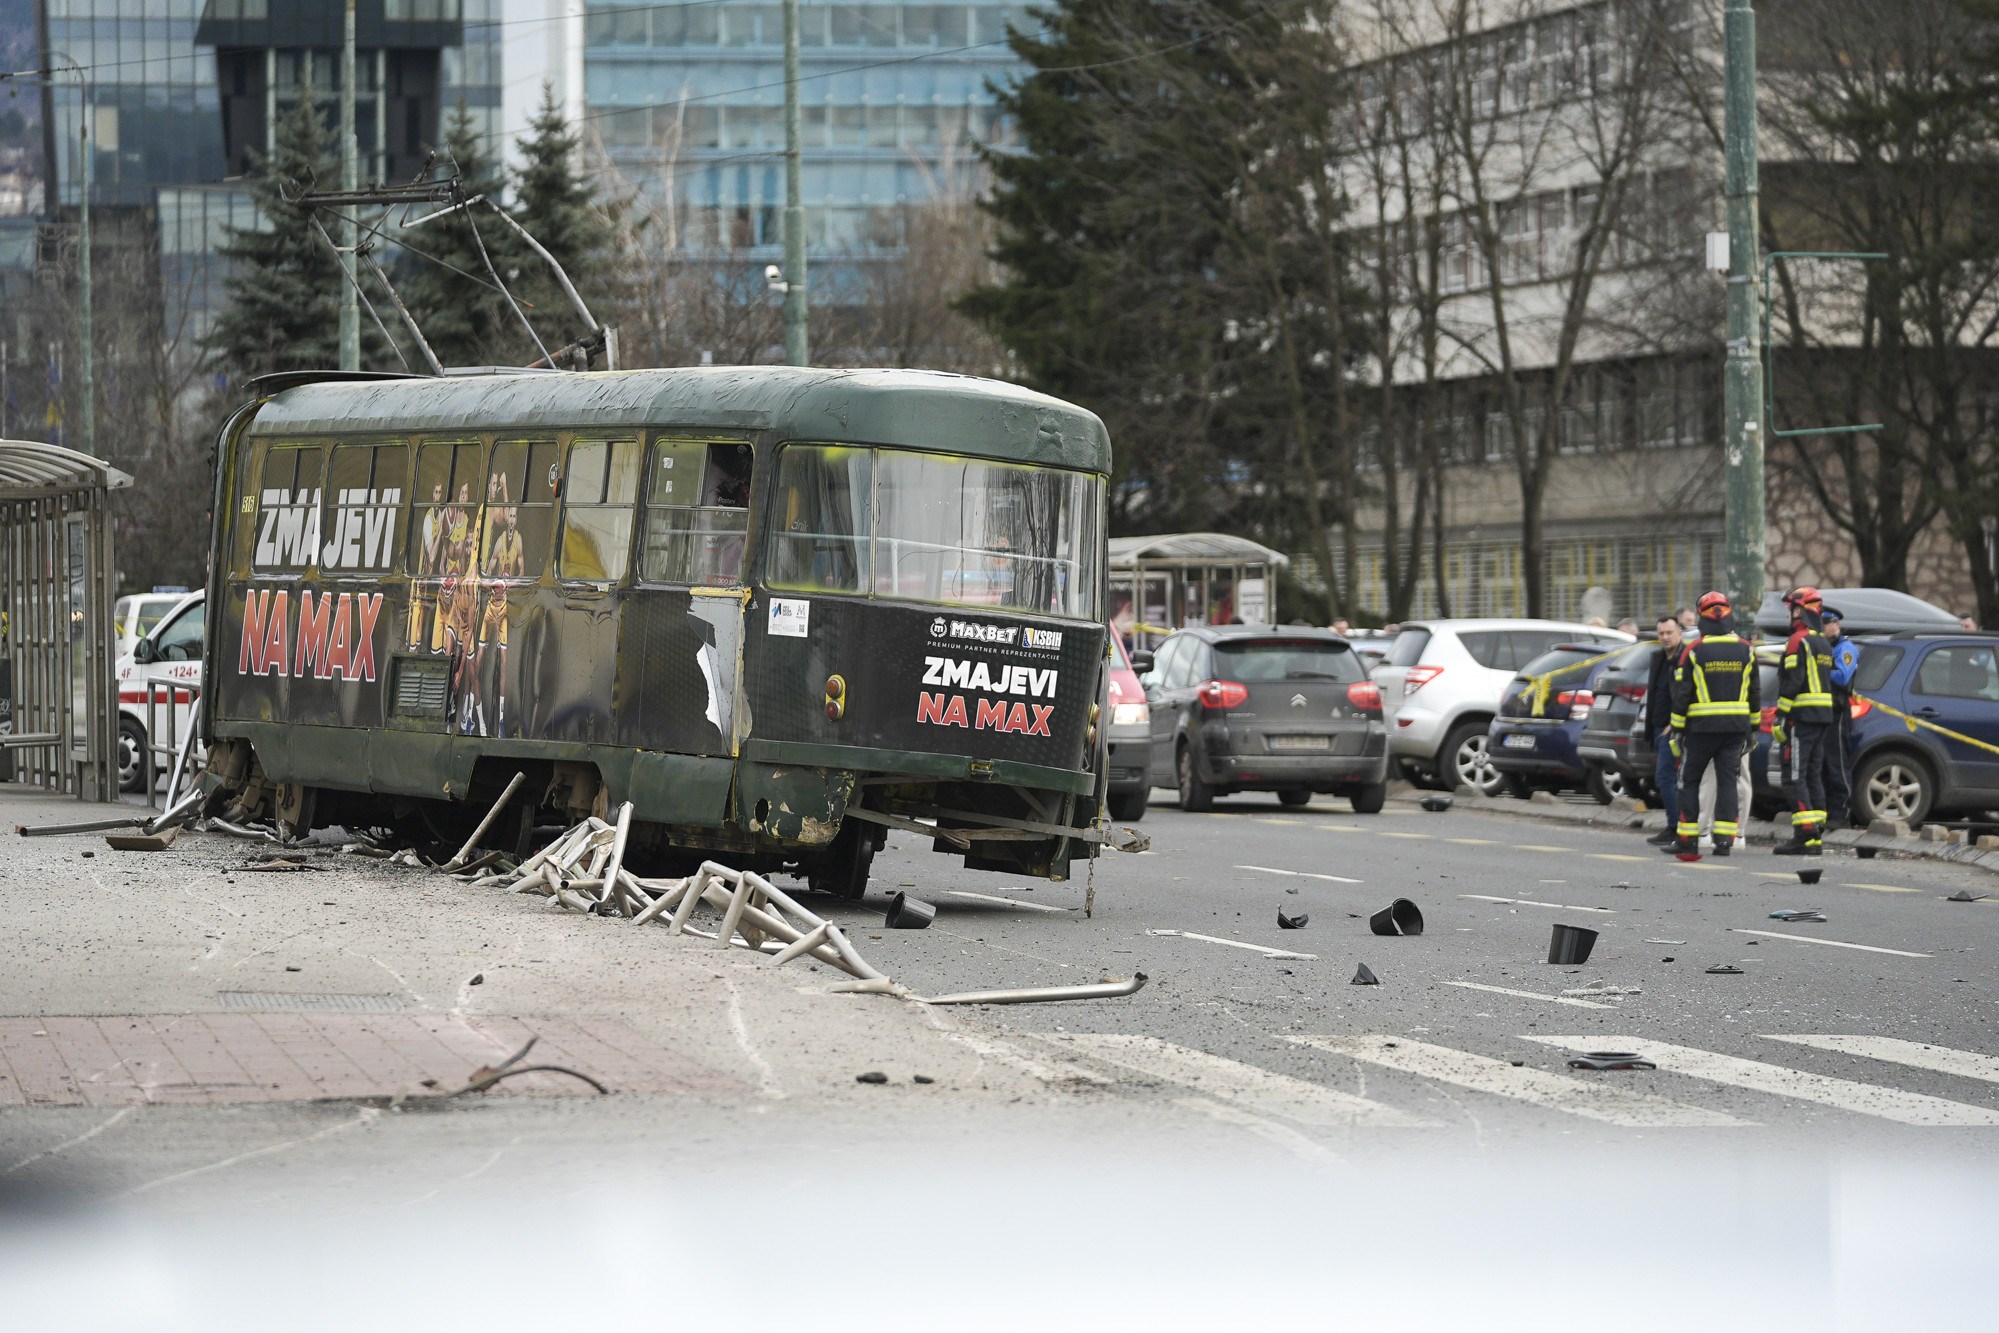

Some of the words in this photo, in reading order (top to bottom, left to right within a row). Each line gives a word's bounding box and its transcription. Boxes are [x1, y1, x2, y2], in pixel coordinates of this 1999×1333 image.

[255, 487, 401, 569] ZMAJEVI
[239, 589, 288, 676] NA
[294, 590, 384, 682] MAX
[927, 640, 961, 650] PREMIUM
[964, 644, 998, 654] PARTNER
[1001, 649, 1060, 661] REPREZENTACIJE
[1033, 629, 1062, 647] KSBIH
[922, 655, 1059, 698] ZMAJEVI
[917, 691, 969, 728] NA
[975, 698, 1055, 737] MAX
